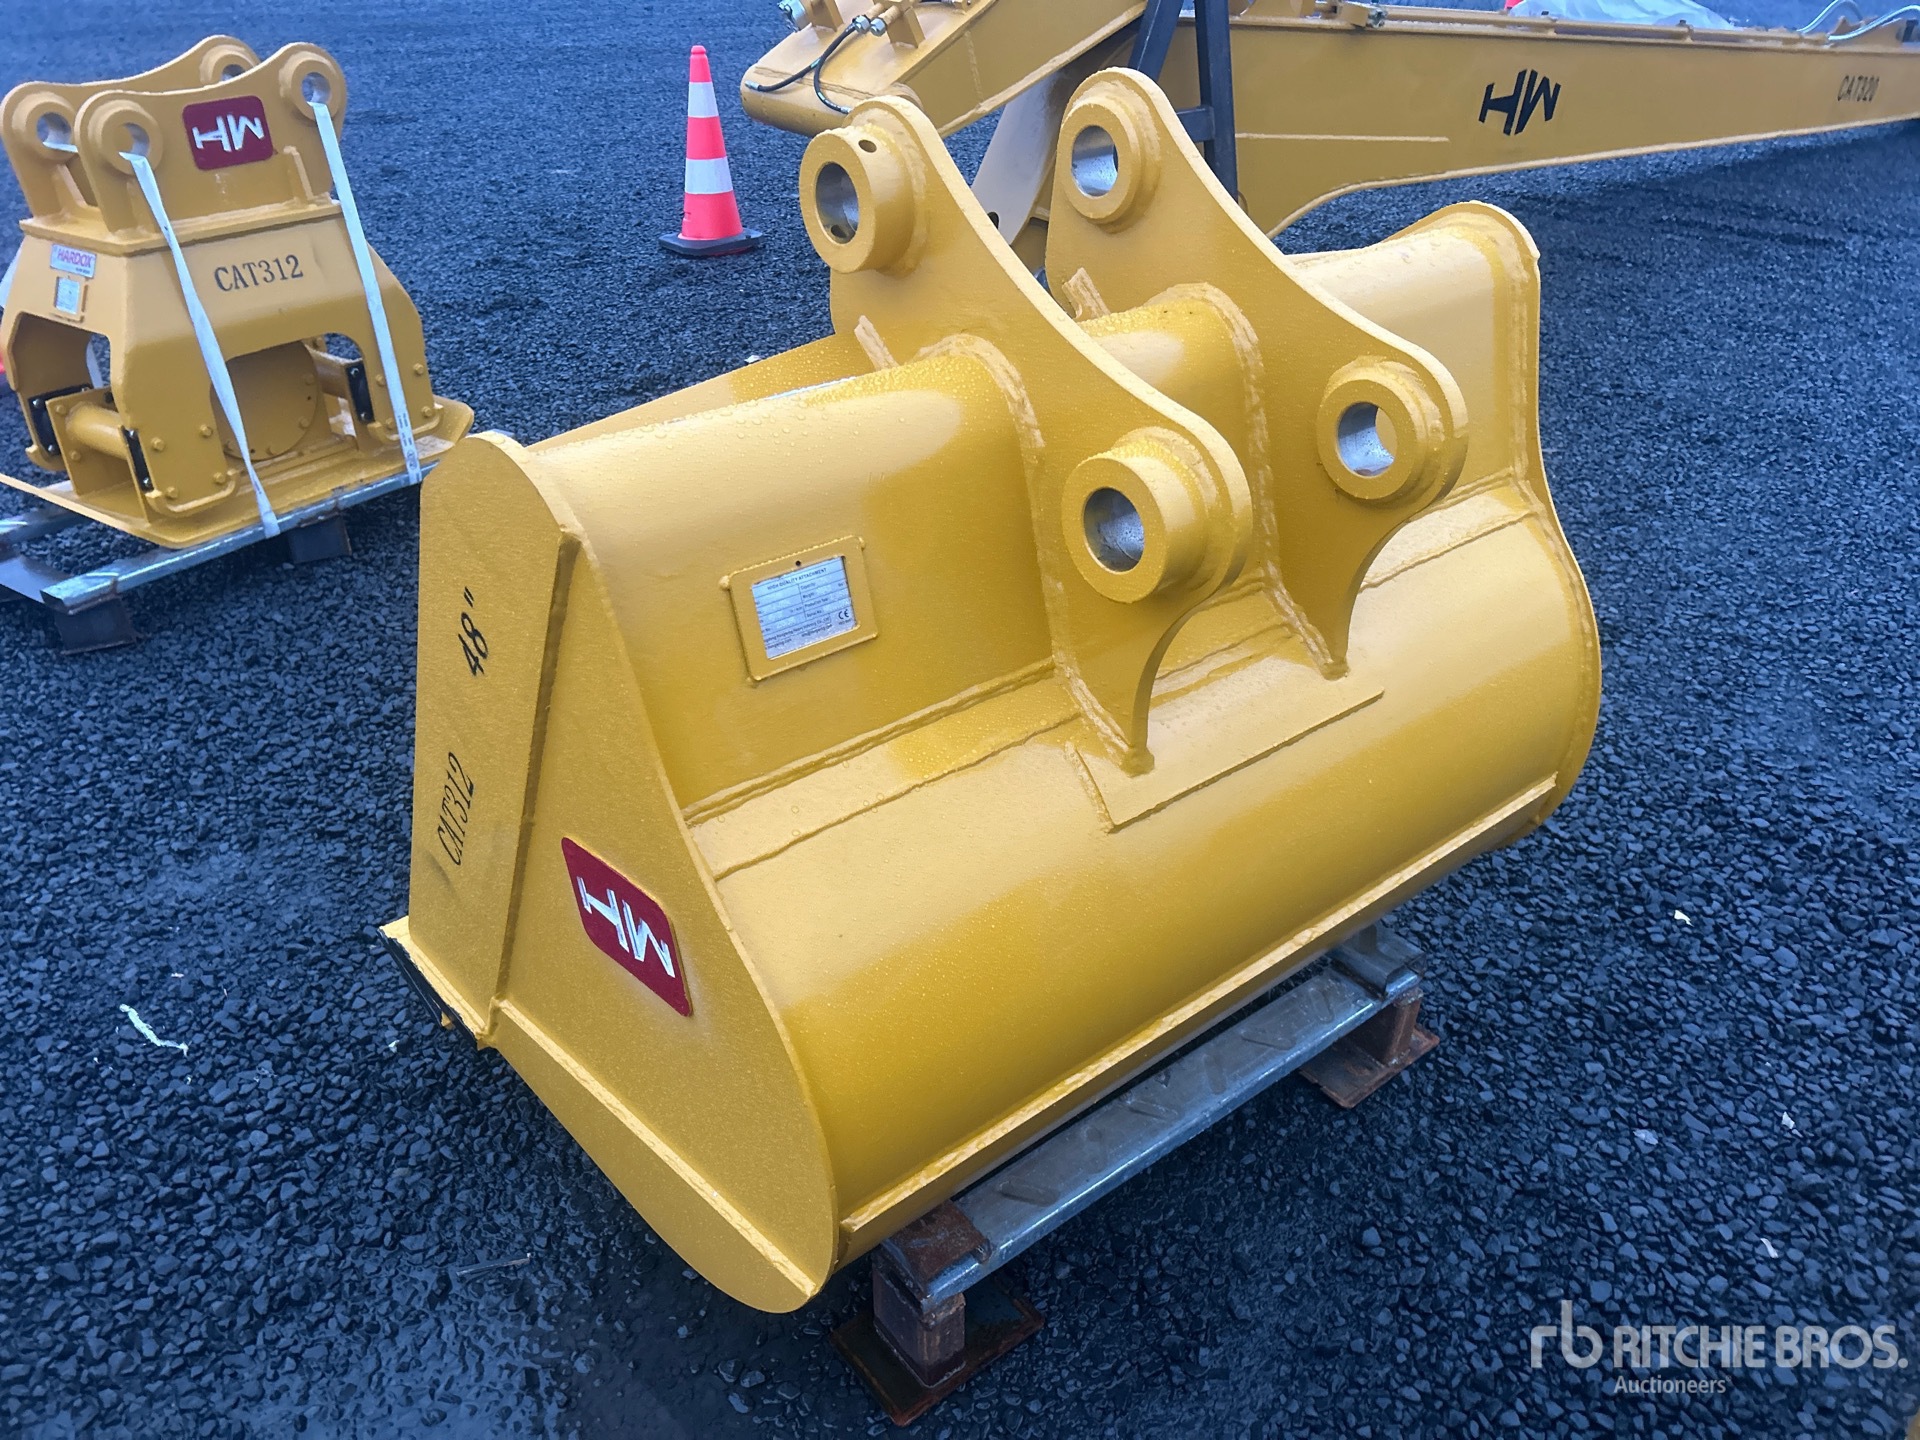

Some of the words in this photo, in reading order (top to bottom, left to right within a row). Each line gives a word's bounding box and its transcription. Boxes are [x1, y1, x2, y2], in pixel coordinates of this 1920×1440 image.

[1478, 69, 1561, 136] HW
[57, 248, 93, 268] HARDOX
[214, 254, 304, 292] CAT312
[780, 576, 798, 586] QUALITY
[798, 567, 827, 580] ATTACHMENT
[436, 752, 475, 866] CAT312
